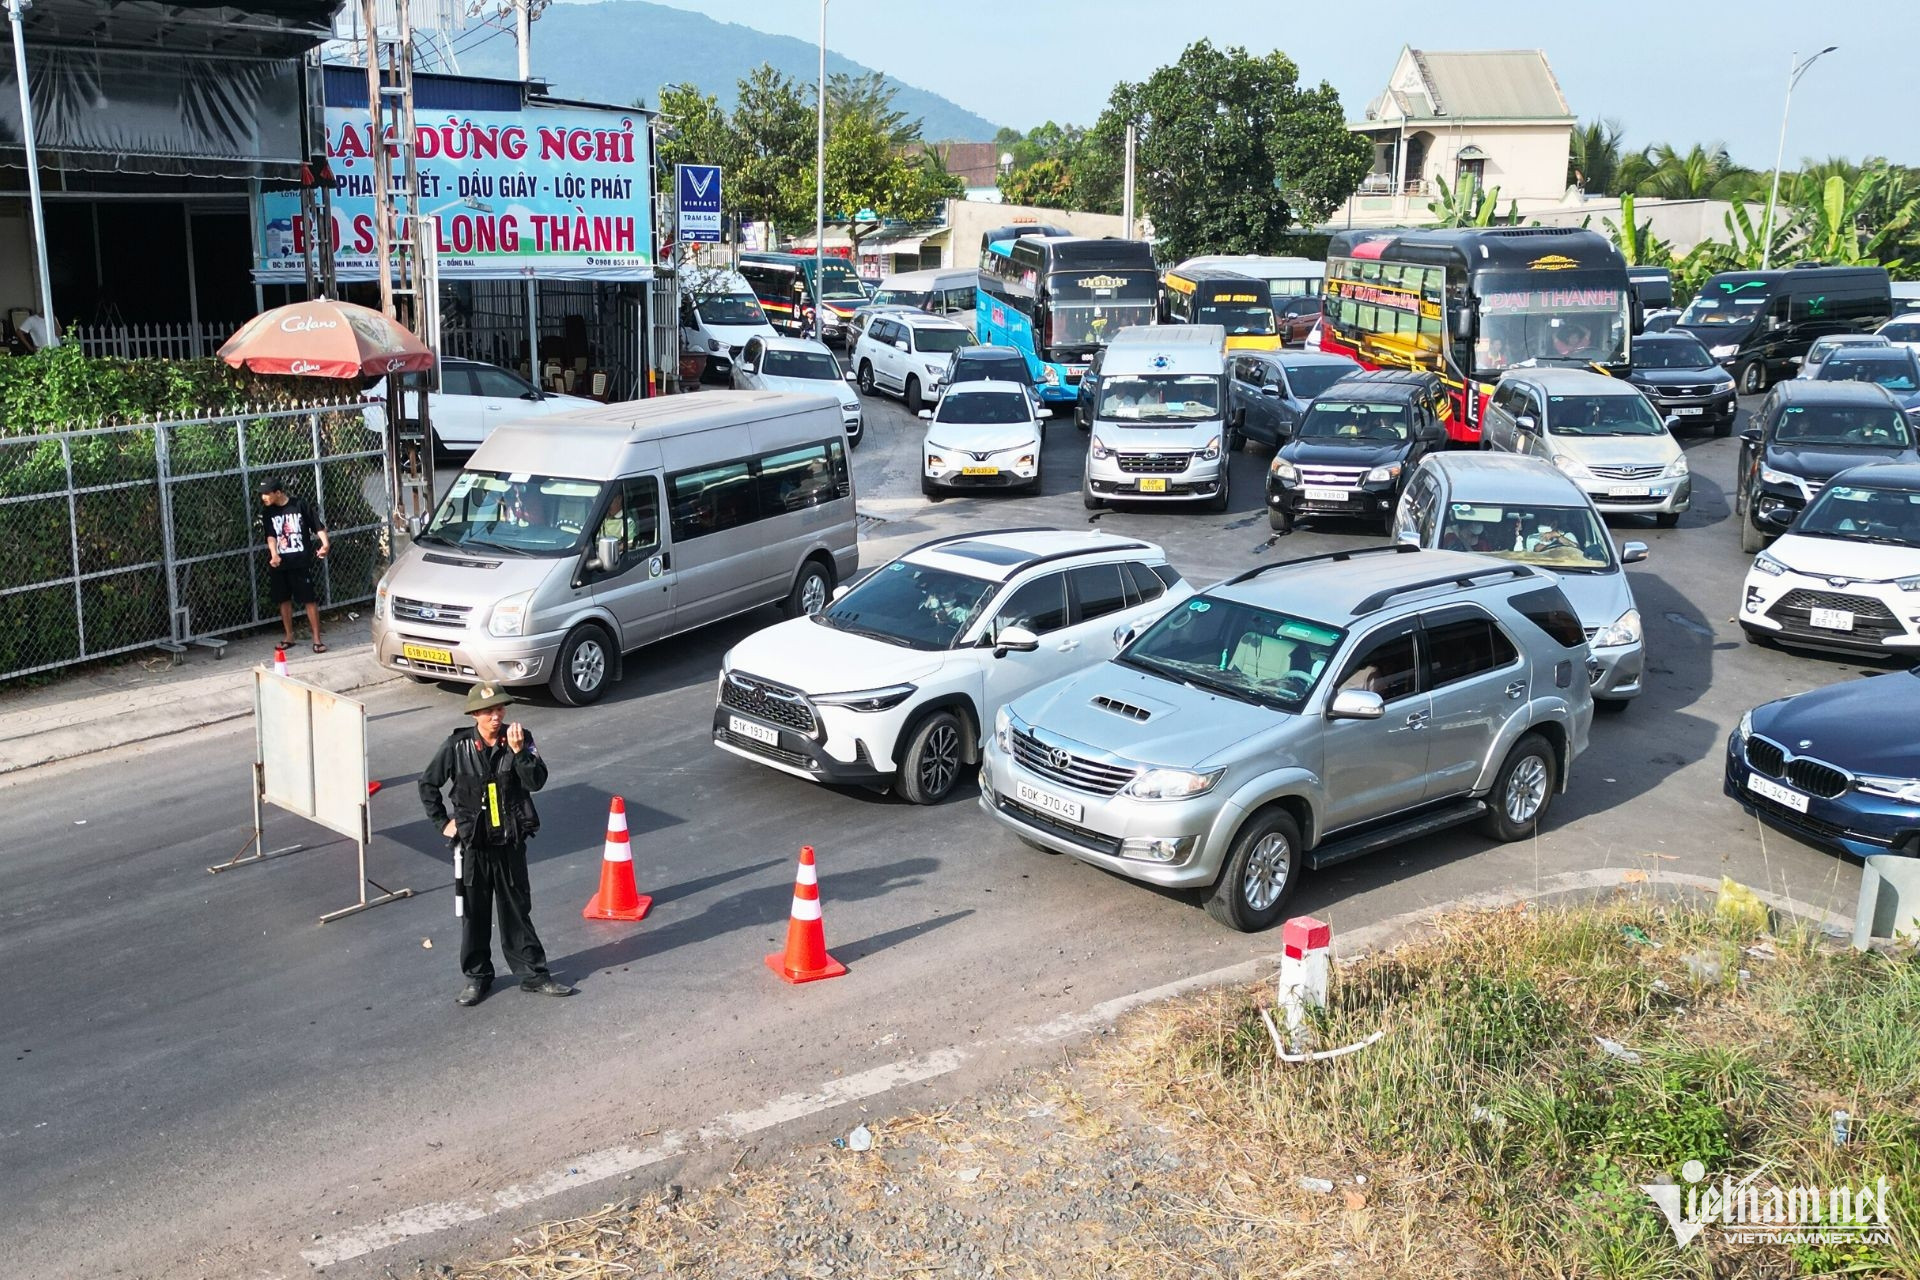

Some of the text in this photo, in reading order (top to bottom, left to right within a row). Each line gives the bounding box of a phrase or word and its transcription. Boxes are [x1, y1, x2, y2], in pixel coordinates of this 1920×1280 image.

[415, 117, 529, 160] DỪNG
[538, 118, 636, 163] NGHỈ
[458, 168, 494, 198] DẦU
[499, 172, 538, 199] GIÂY
[554, 172, 586, 203] LỘC
[591, 174, 632, 200] PHÁT
[436, 214, 519, 254] LONG
[529, 206, 635, 253] THÀNH
[1489, 283, 1618, 312] ĐẠT THÀNH
[281, 316, 337, 333] Celano
[290, 360, 321, 375] Celano
[1021, 785, 1039, 802] 60K
